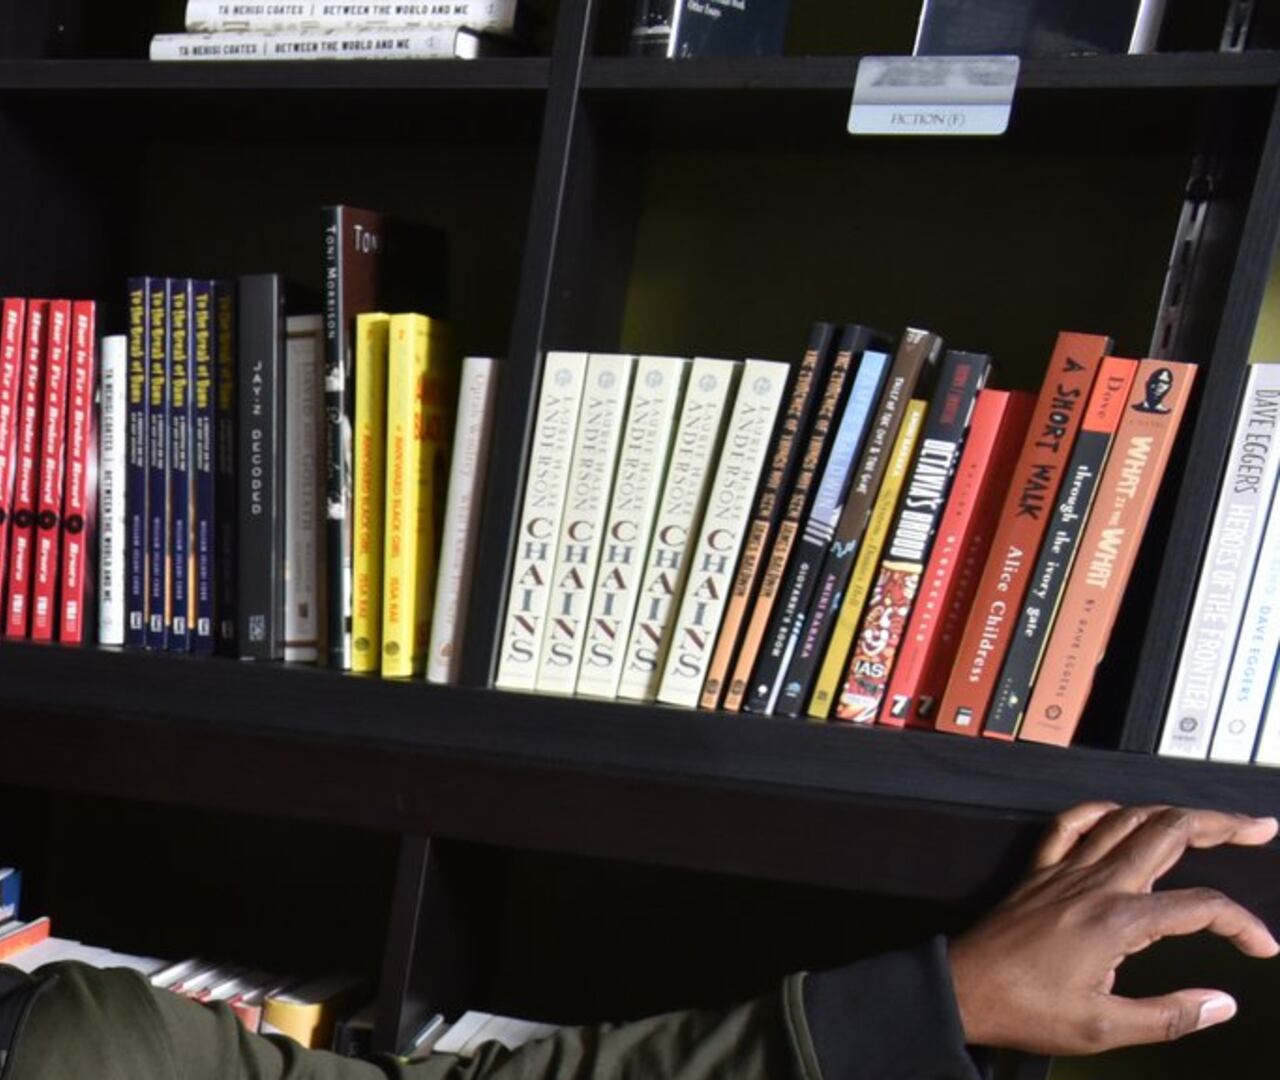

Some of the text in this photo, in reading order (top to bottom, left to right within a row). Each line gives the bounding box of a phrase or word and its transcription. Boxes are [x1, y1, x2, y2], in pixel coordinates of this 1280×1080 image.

[322, 4, 369, 15] BETWEEN
[374, 4, 391, 15] THE
[395, 4, 429, 15] WORLD
[431, 4, 452, 15] AND
[454, 4, 470, 15] ME
[890, 112, 946, 127] FICTION
[1018, 357, 1085, 522] A SHORT WALK
[1097, 376, 1124, 420] Dove
[1235, 387, 1280, 495] DAVE EGGERS
[251, 429, 262, 515] DECODED
[906, 438, 957, 509] OCTAVIA'S
[504, 516, 555, 664] CHAINS
[545, 519, 596, 668] CHAINS
[585, 519, 638, 669] CHAINS
[628, 524, 689, 673] CHAINS
[673, 528, 737, 679] CHAINS
[1023, 464, 1091, 639] through the ivory gate
[771, 621, 789, 658] ROOM
[801, 573, 836, 659] AMIRI BARAKA
[968, 544, 1024, 684] Alice Childress
